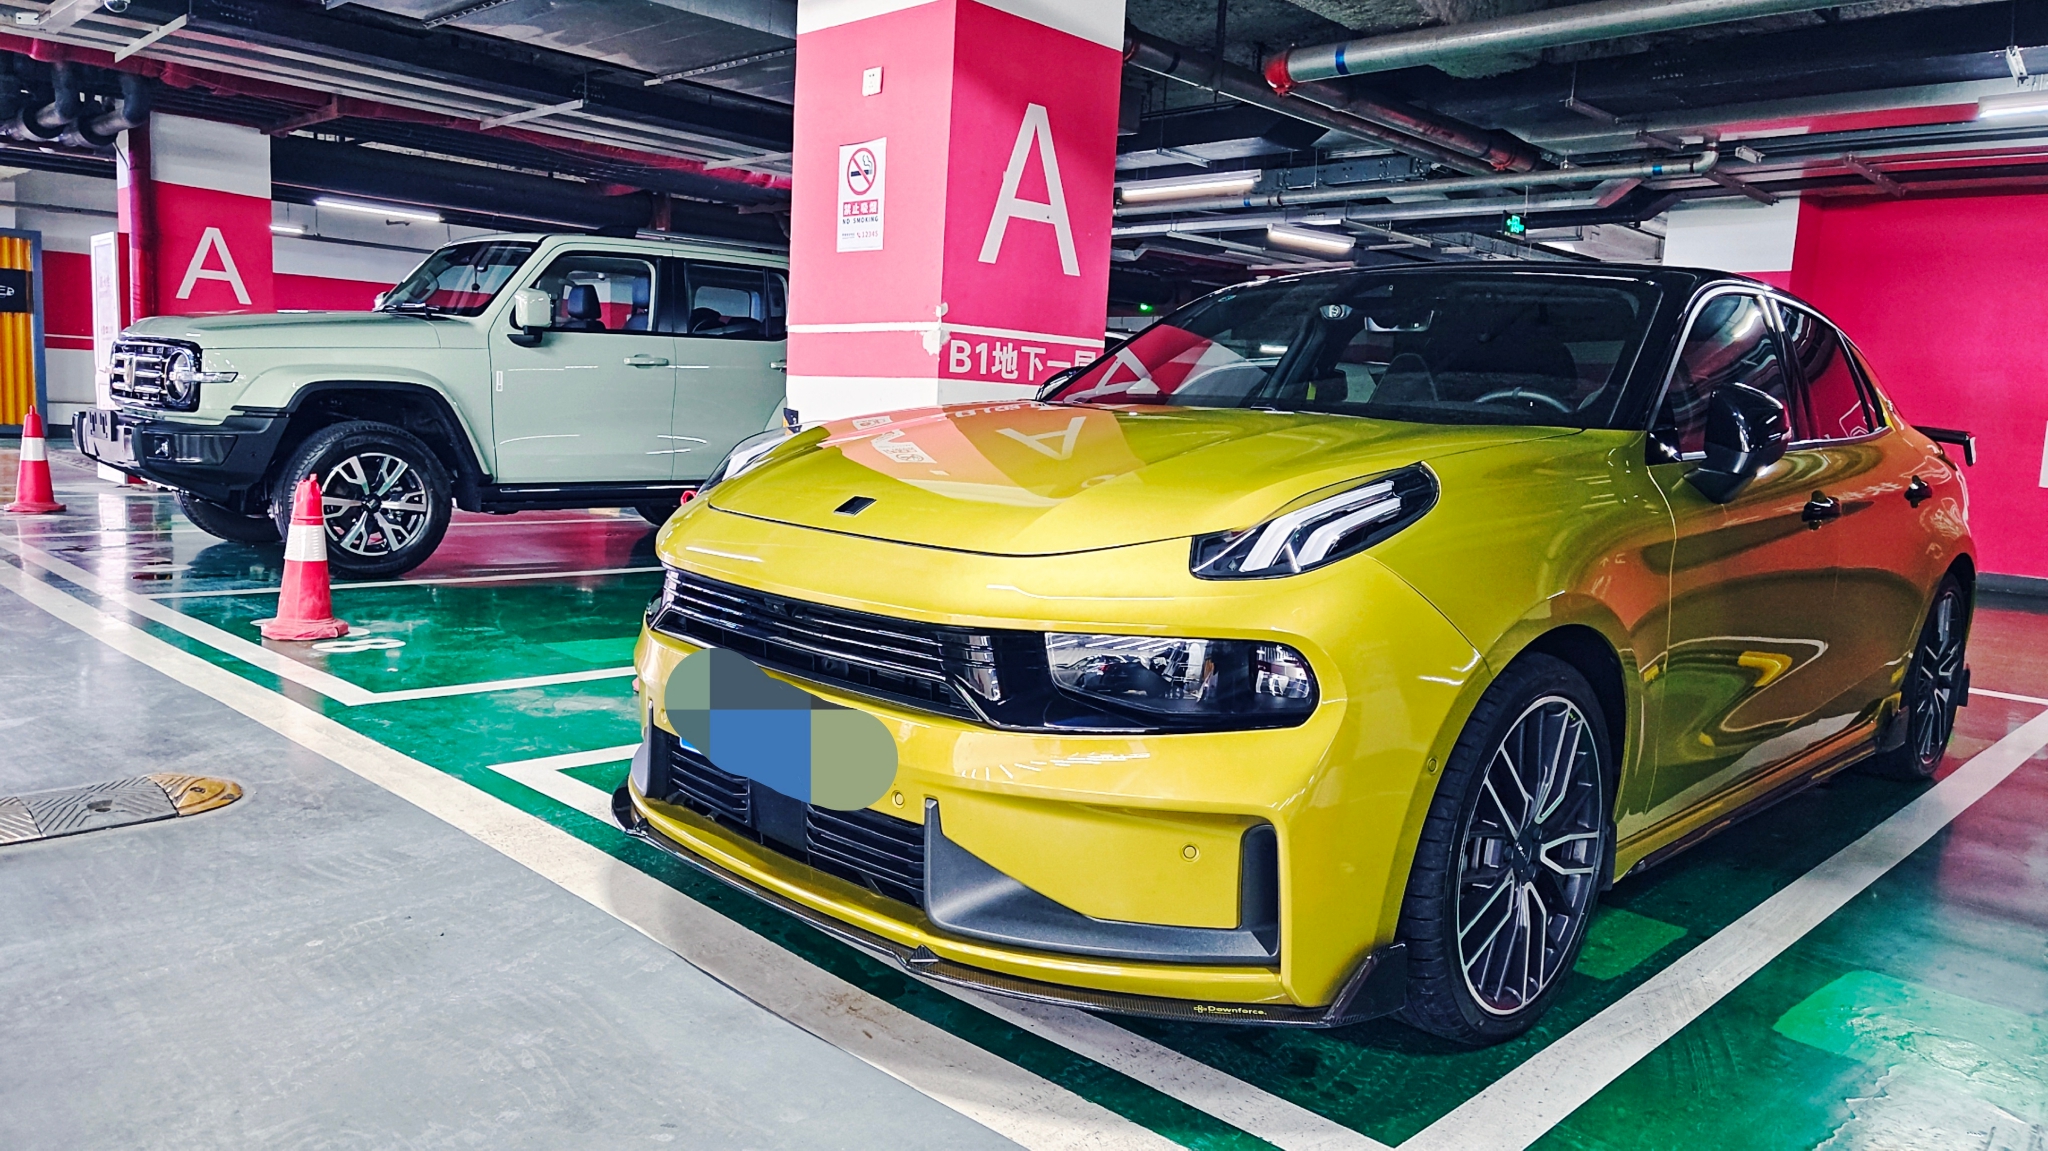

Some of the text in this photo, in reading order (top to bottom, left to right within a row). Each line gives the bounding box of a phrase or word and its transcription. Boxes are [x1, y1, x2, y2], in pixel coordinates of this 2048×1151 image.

[978, 102, 1081, 277] A
[853, 215, 878, 223] SMOKING
[862, 230, 878, 238] 12345
[175, 226, 253, 305] A
